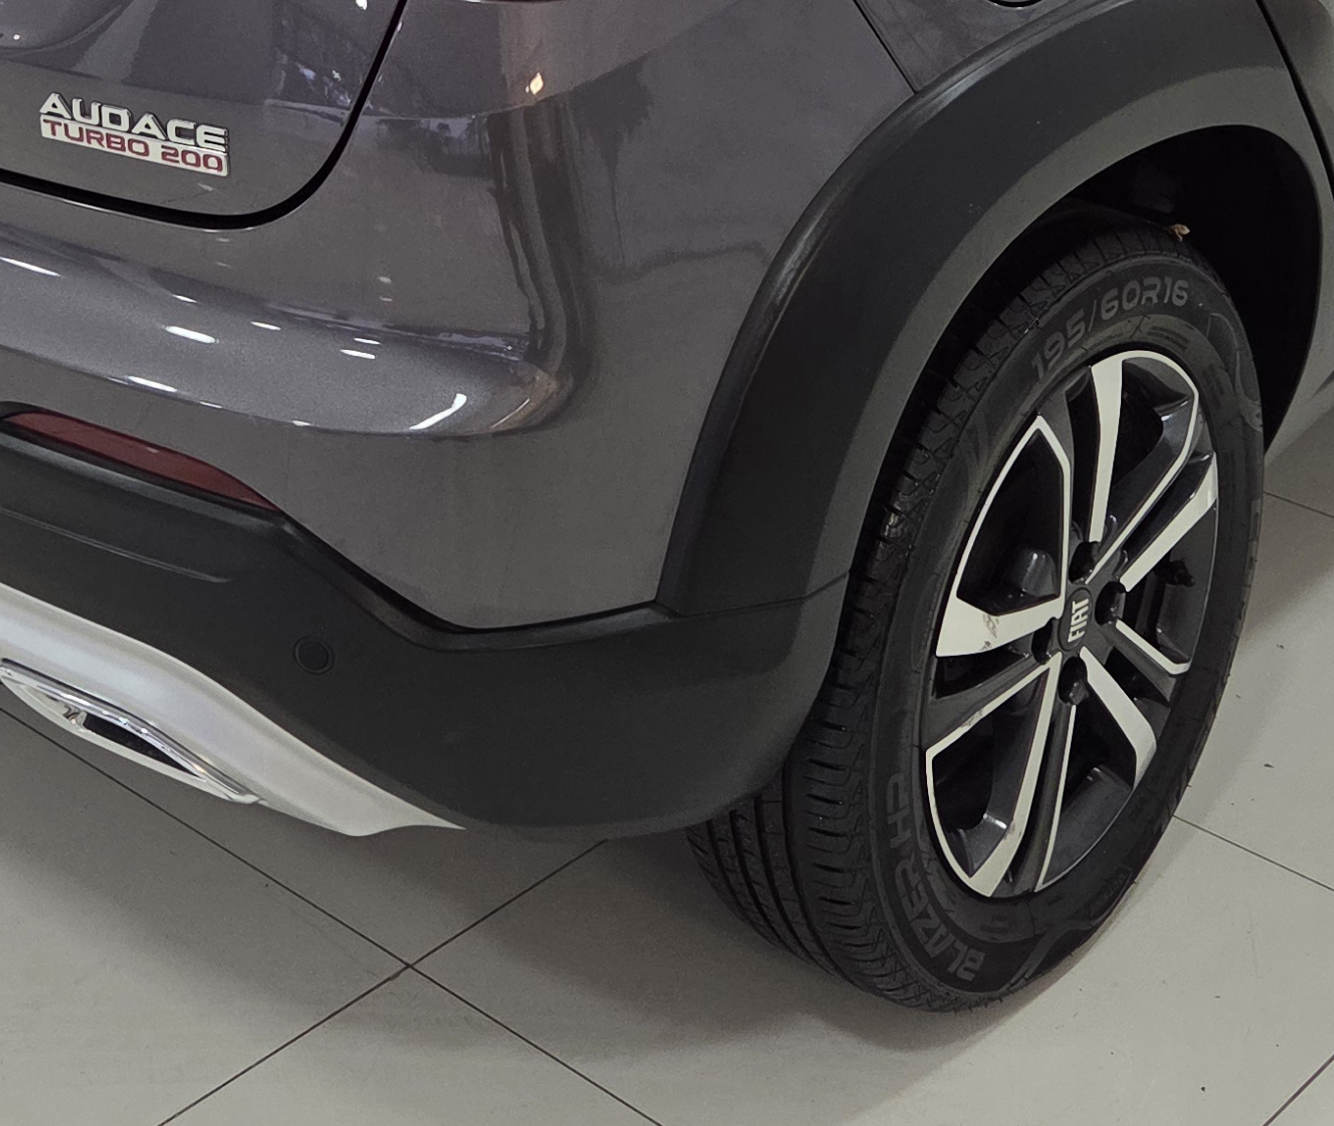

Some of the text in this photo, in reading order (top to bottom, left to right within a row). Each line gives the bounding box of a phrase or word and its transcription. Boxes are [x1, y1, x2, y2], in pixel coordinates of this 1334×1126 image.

[39, 92, 229, 153] AUDACE
[43, 118, 223, 173] TURBO 200
[1031, 276, 1189, 380] 195/60R16
[1068, 598, 1089, 643] FIAT
